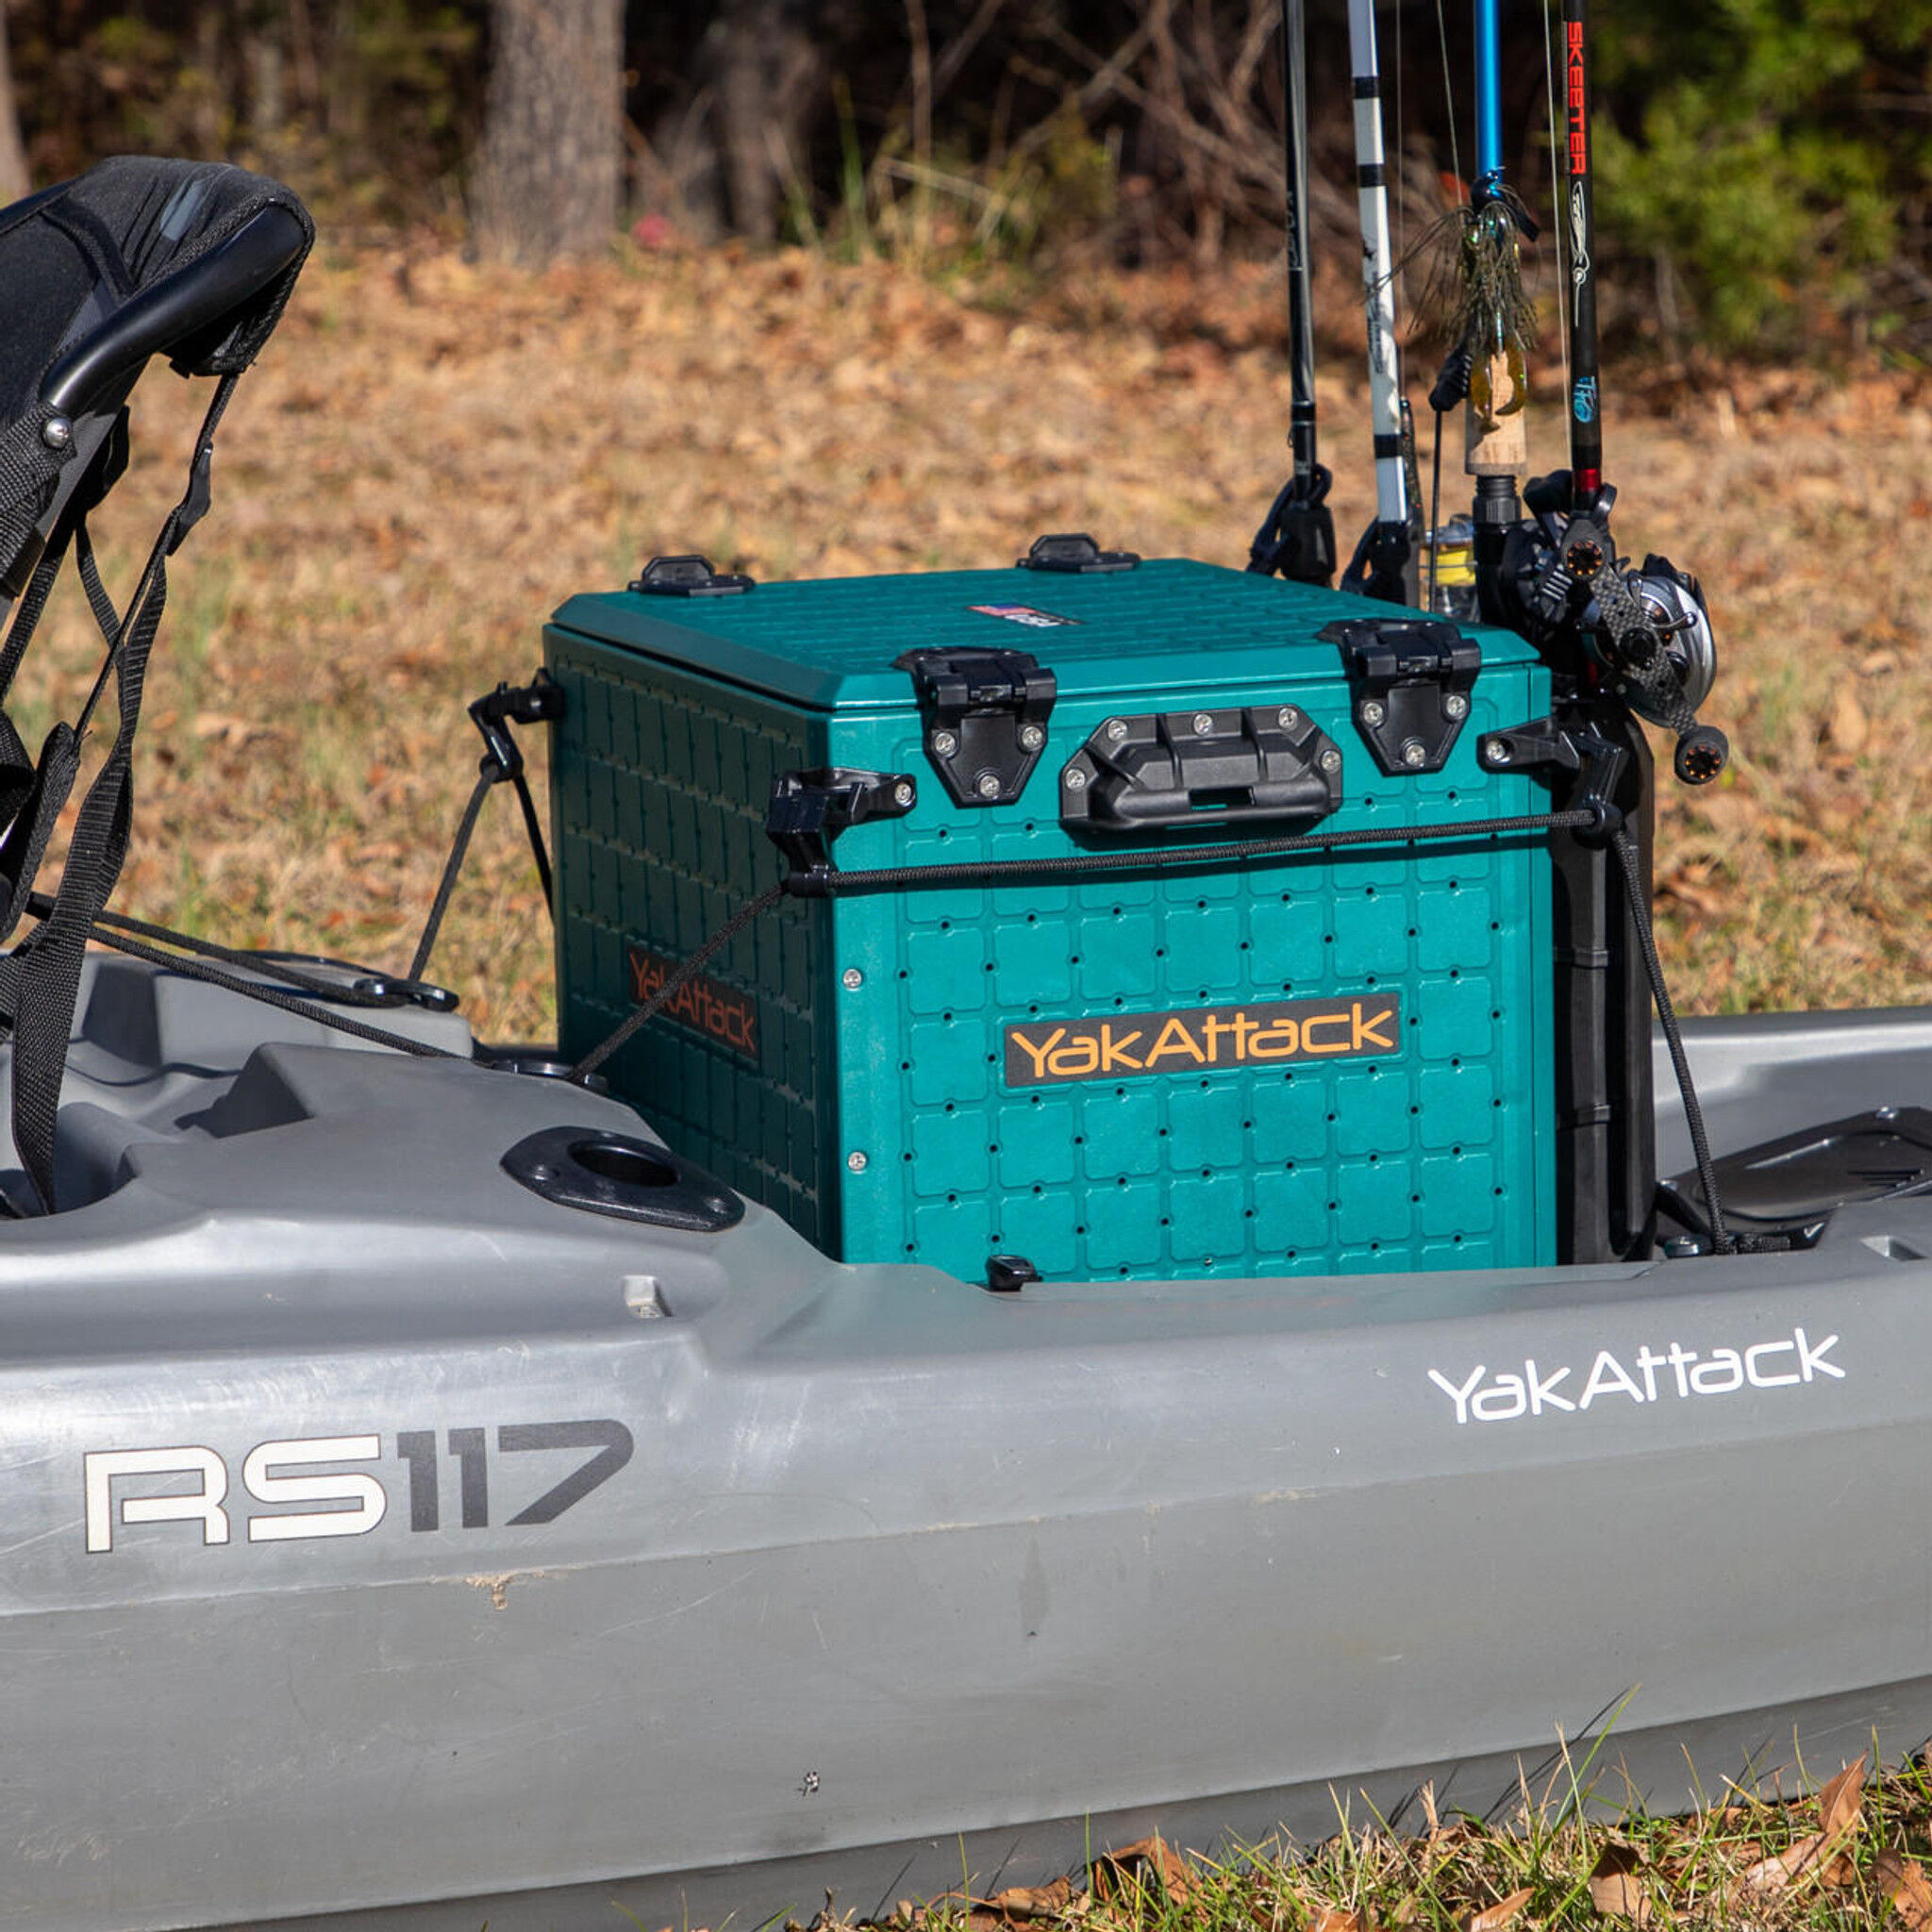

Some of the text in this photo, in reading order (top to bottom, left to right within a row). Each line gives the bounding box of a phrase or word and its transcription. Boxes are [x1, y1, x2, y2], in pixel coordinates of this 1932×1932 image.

[1568, 22, 1587, 174] SKEETER
[1011, 1003, 1394, 1077] YakAttack
[1427, 1327, 1847, 1424] YakAttack
[84, 1419, 634, 1554] RS117
